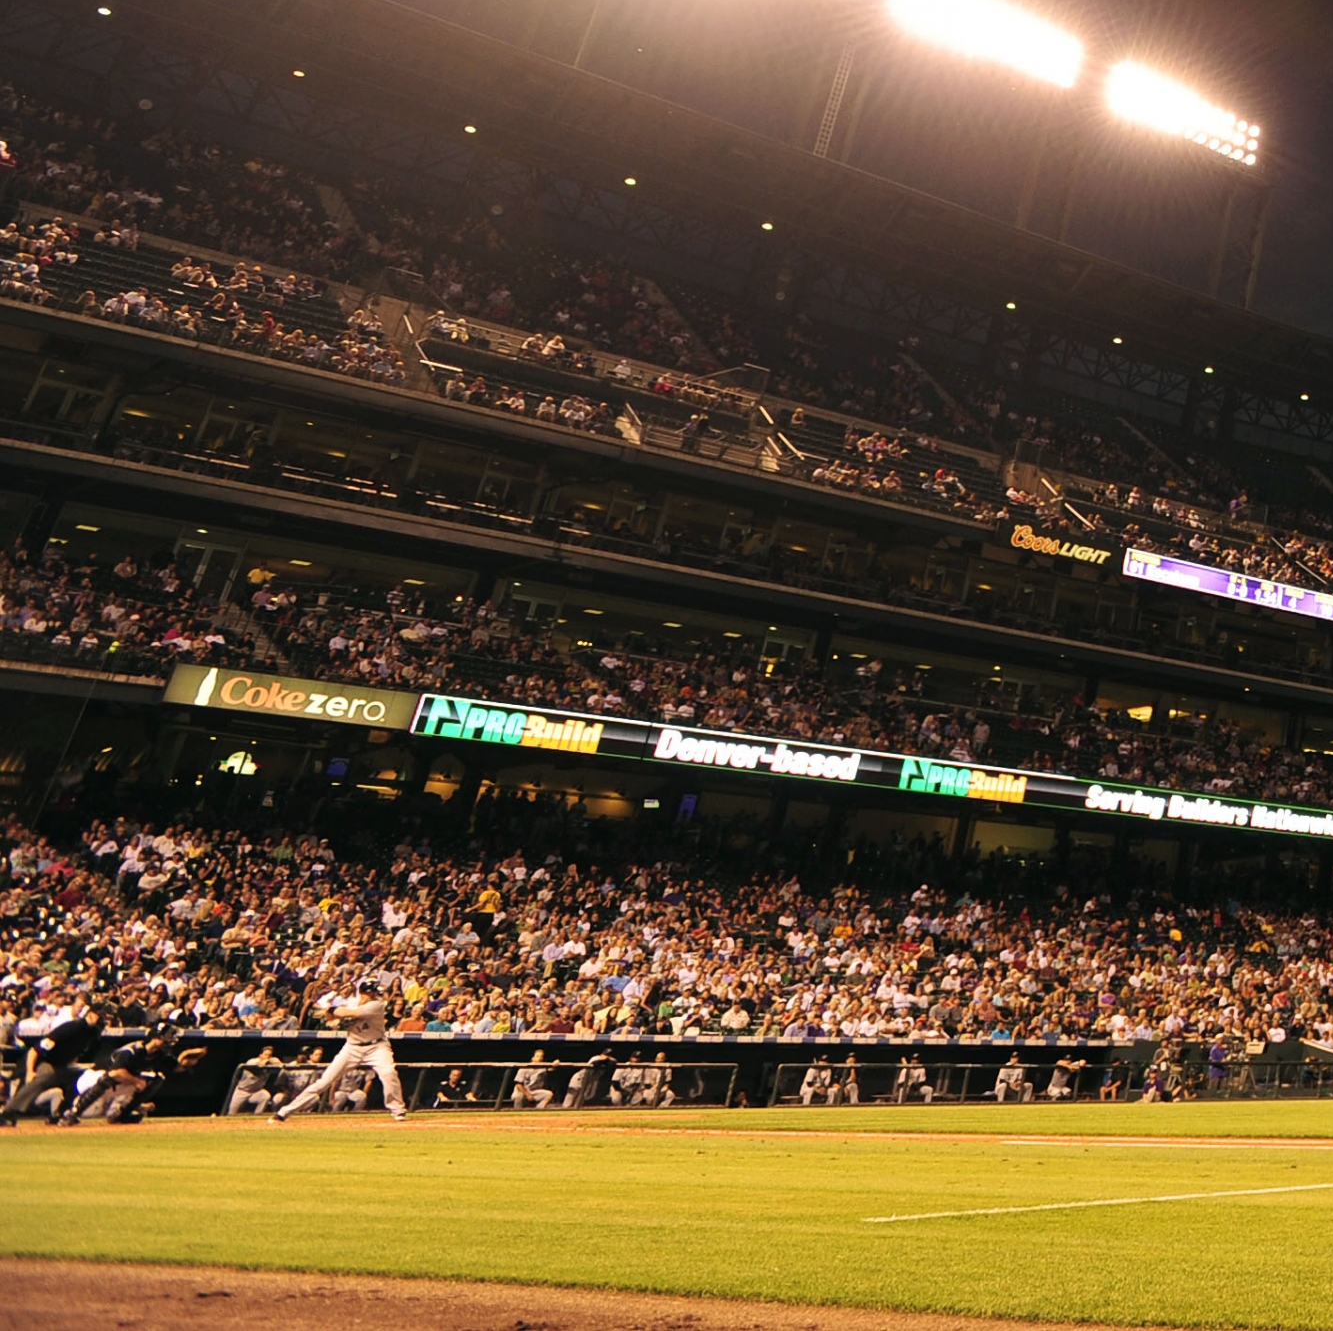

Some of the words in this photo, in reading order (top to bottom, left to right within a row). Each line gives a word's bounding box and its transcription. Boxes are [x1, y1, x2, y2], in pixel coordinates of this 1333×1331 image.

[1010, 524, 1060, 555] Coors
[1059, 542, 1111, 565] LIGHT
[219, 677, 306, 711] Coke
[463, 706, 603, 754] PROBuild
[654, 729, 861, 781] Denver-based
[1086, 785, 1165, 819] Serving
[1167, 794, 1248, 826] Builders
